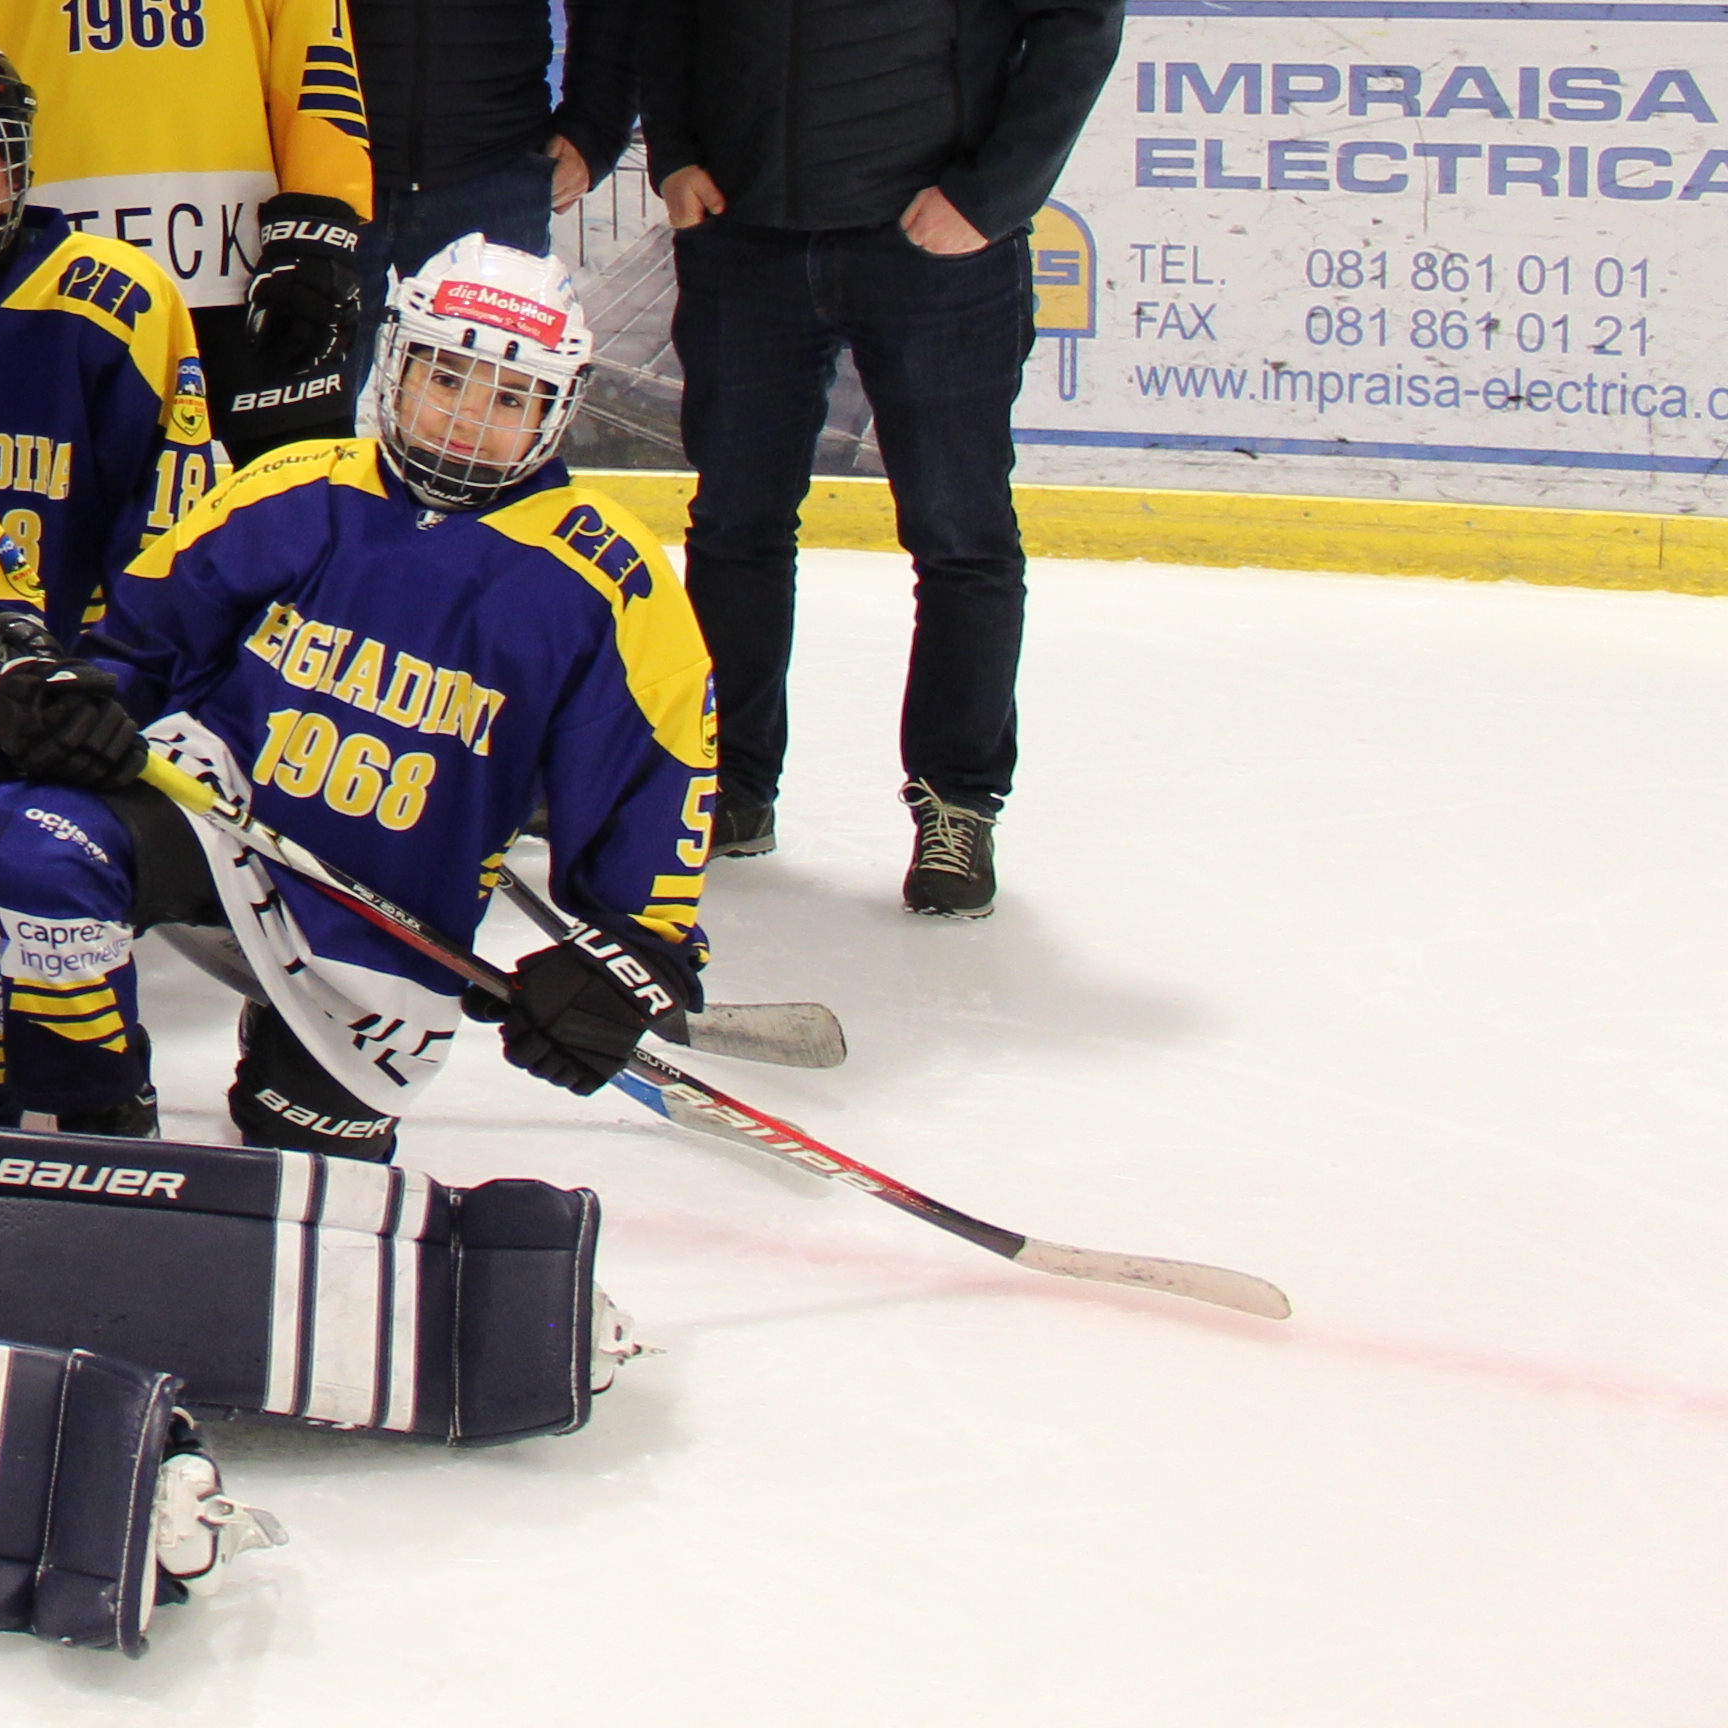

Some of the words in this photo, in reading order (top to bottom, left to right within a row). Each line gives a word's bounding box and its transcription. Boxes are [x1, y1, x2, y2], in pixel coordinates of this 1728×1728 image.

[1135, 62, 1719, 124] IMPRAISA
[1130, 244, 1226, 285] TEL.
[1305, 249, 1389, 291] 081
[1410, 251, 1495, 293] 861
[1517, 255, 1571, 297] 01
[1594, 257, 1648, 299] 01
[1135, 301, 1217, 341] FAX
[1305, 306, 1389, 347] 081
[1410, 310, 1495, 351] 861
[1516, 314, 1570, 355] 01
[1593, 316, 1648, 357] 21
[147, 447, 206, 531] 18
[250, 707, 437, 833] 1968
[675, 774, 719, 870] 5
[16, 919, 106, 950] caprez
